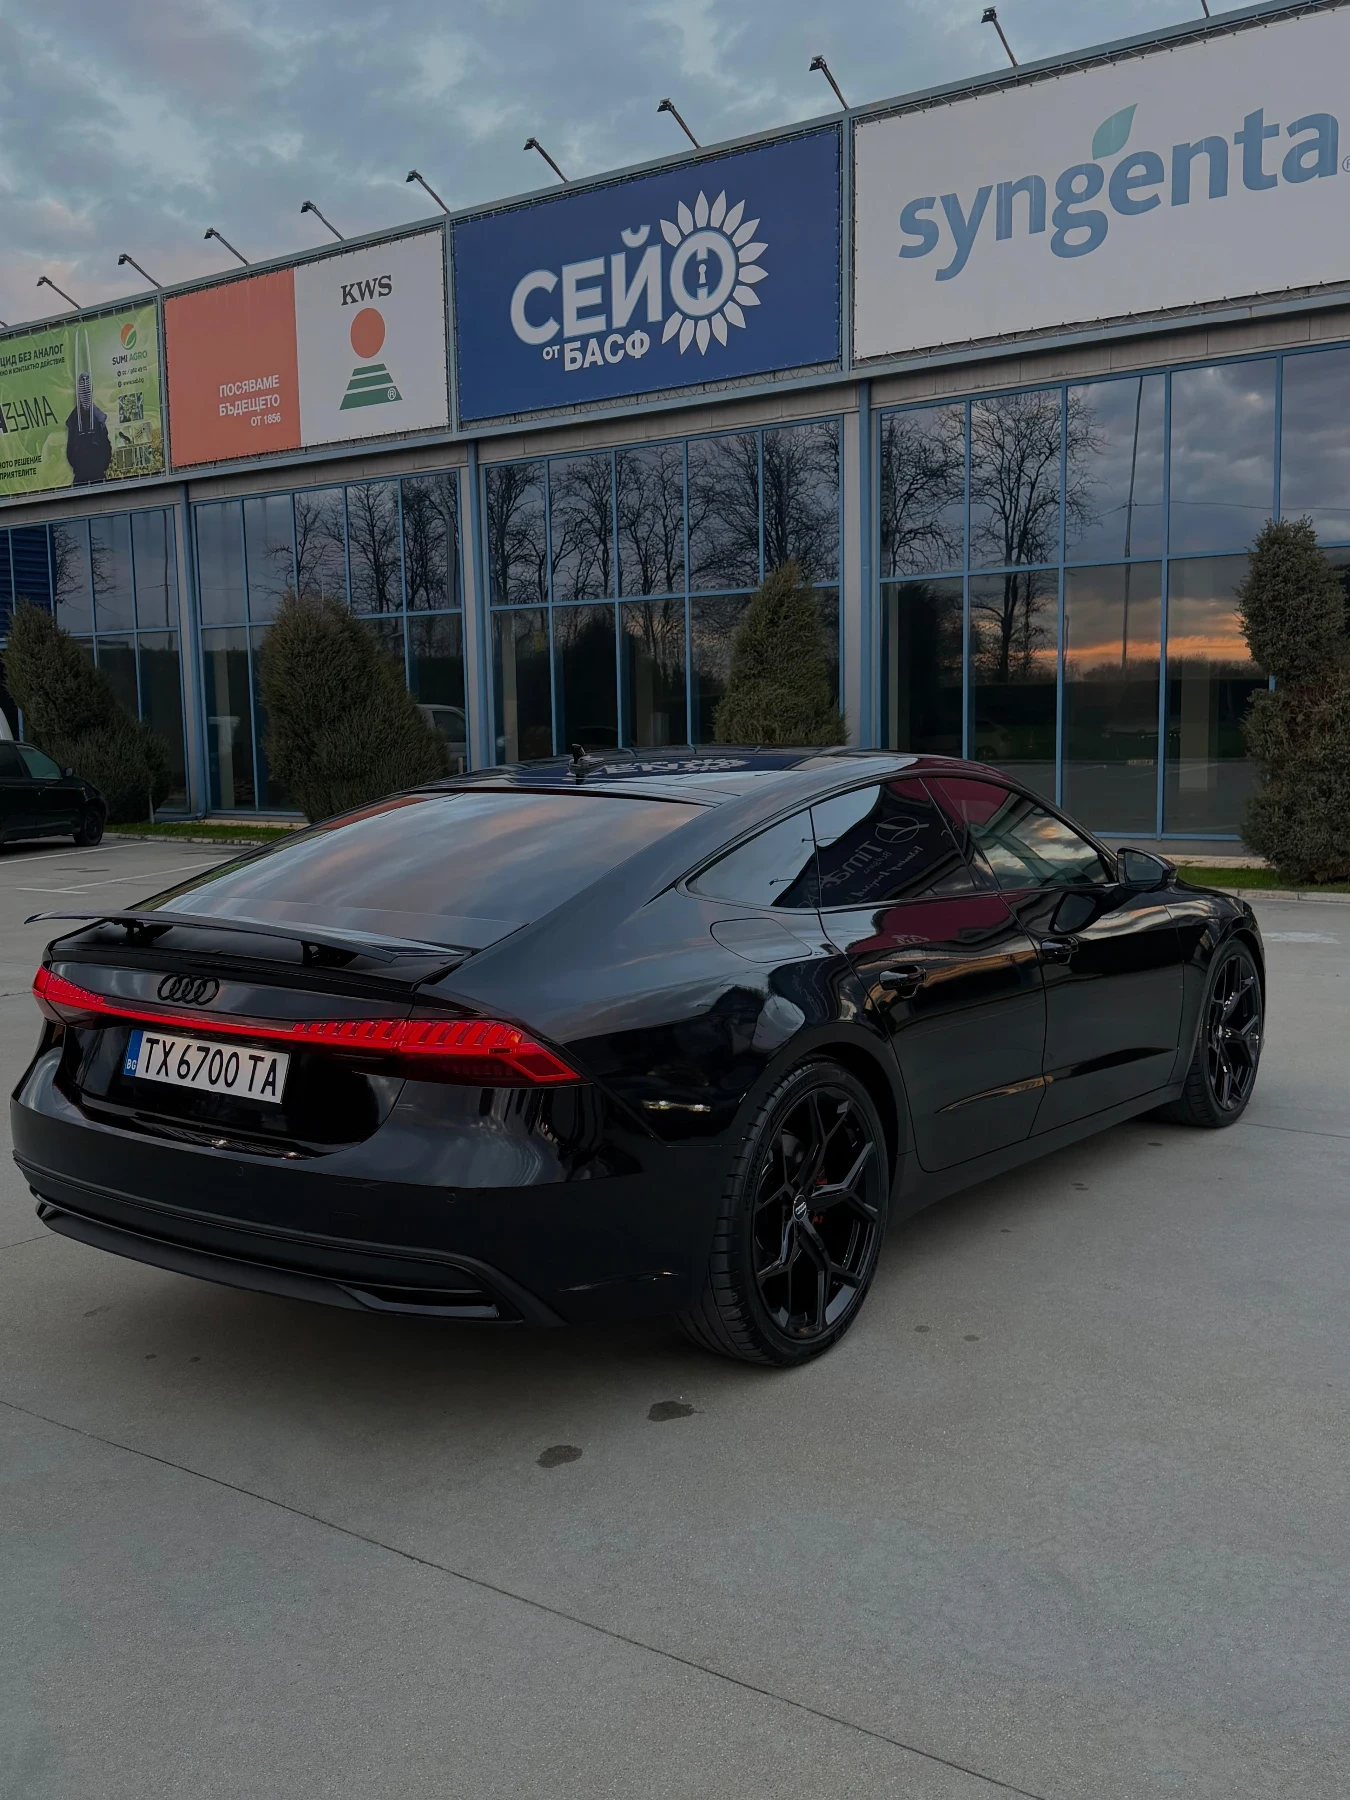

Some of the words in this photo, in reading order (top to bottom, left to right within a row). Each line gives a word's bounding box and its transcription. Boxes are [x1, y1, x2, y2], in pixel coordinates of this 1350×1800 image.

[898, 107, 1339, 281] syngenta
[340, 274, 393, 306] KWS
[0, 354, 17, 368] ЦИД
[18, 350, 32, 363] БЕЗ
[33, 343, 65, 359] АНАЛОГ
[40, 356, 65, 369] ДЕЙСТВИЕ
[112, 354, 127, 365] SUMI
[129, 350, 148, 361] AGRO
[563, 329, 651, 373] БАСФ
[219, 374, 280, 398] ПОСЯВАМЕ
[218, 394, 280, 417] БЪДЕЩЕТО
[250, 415, 262, 427] ОТ
[263, 413, 281, 425] 1856
[14, 455, 42, 467] РЕШЕНИЕ
[125, 1058, 137, 1071] BG
[145, 1037, 176, 1077] TX
[176, 1044, 240, 1088] 6700
[248, 1054, 278, 1096] TA
